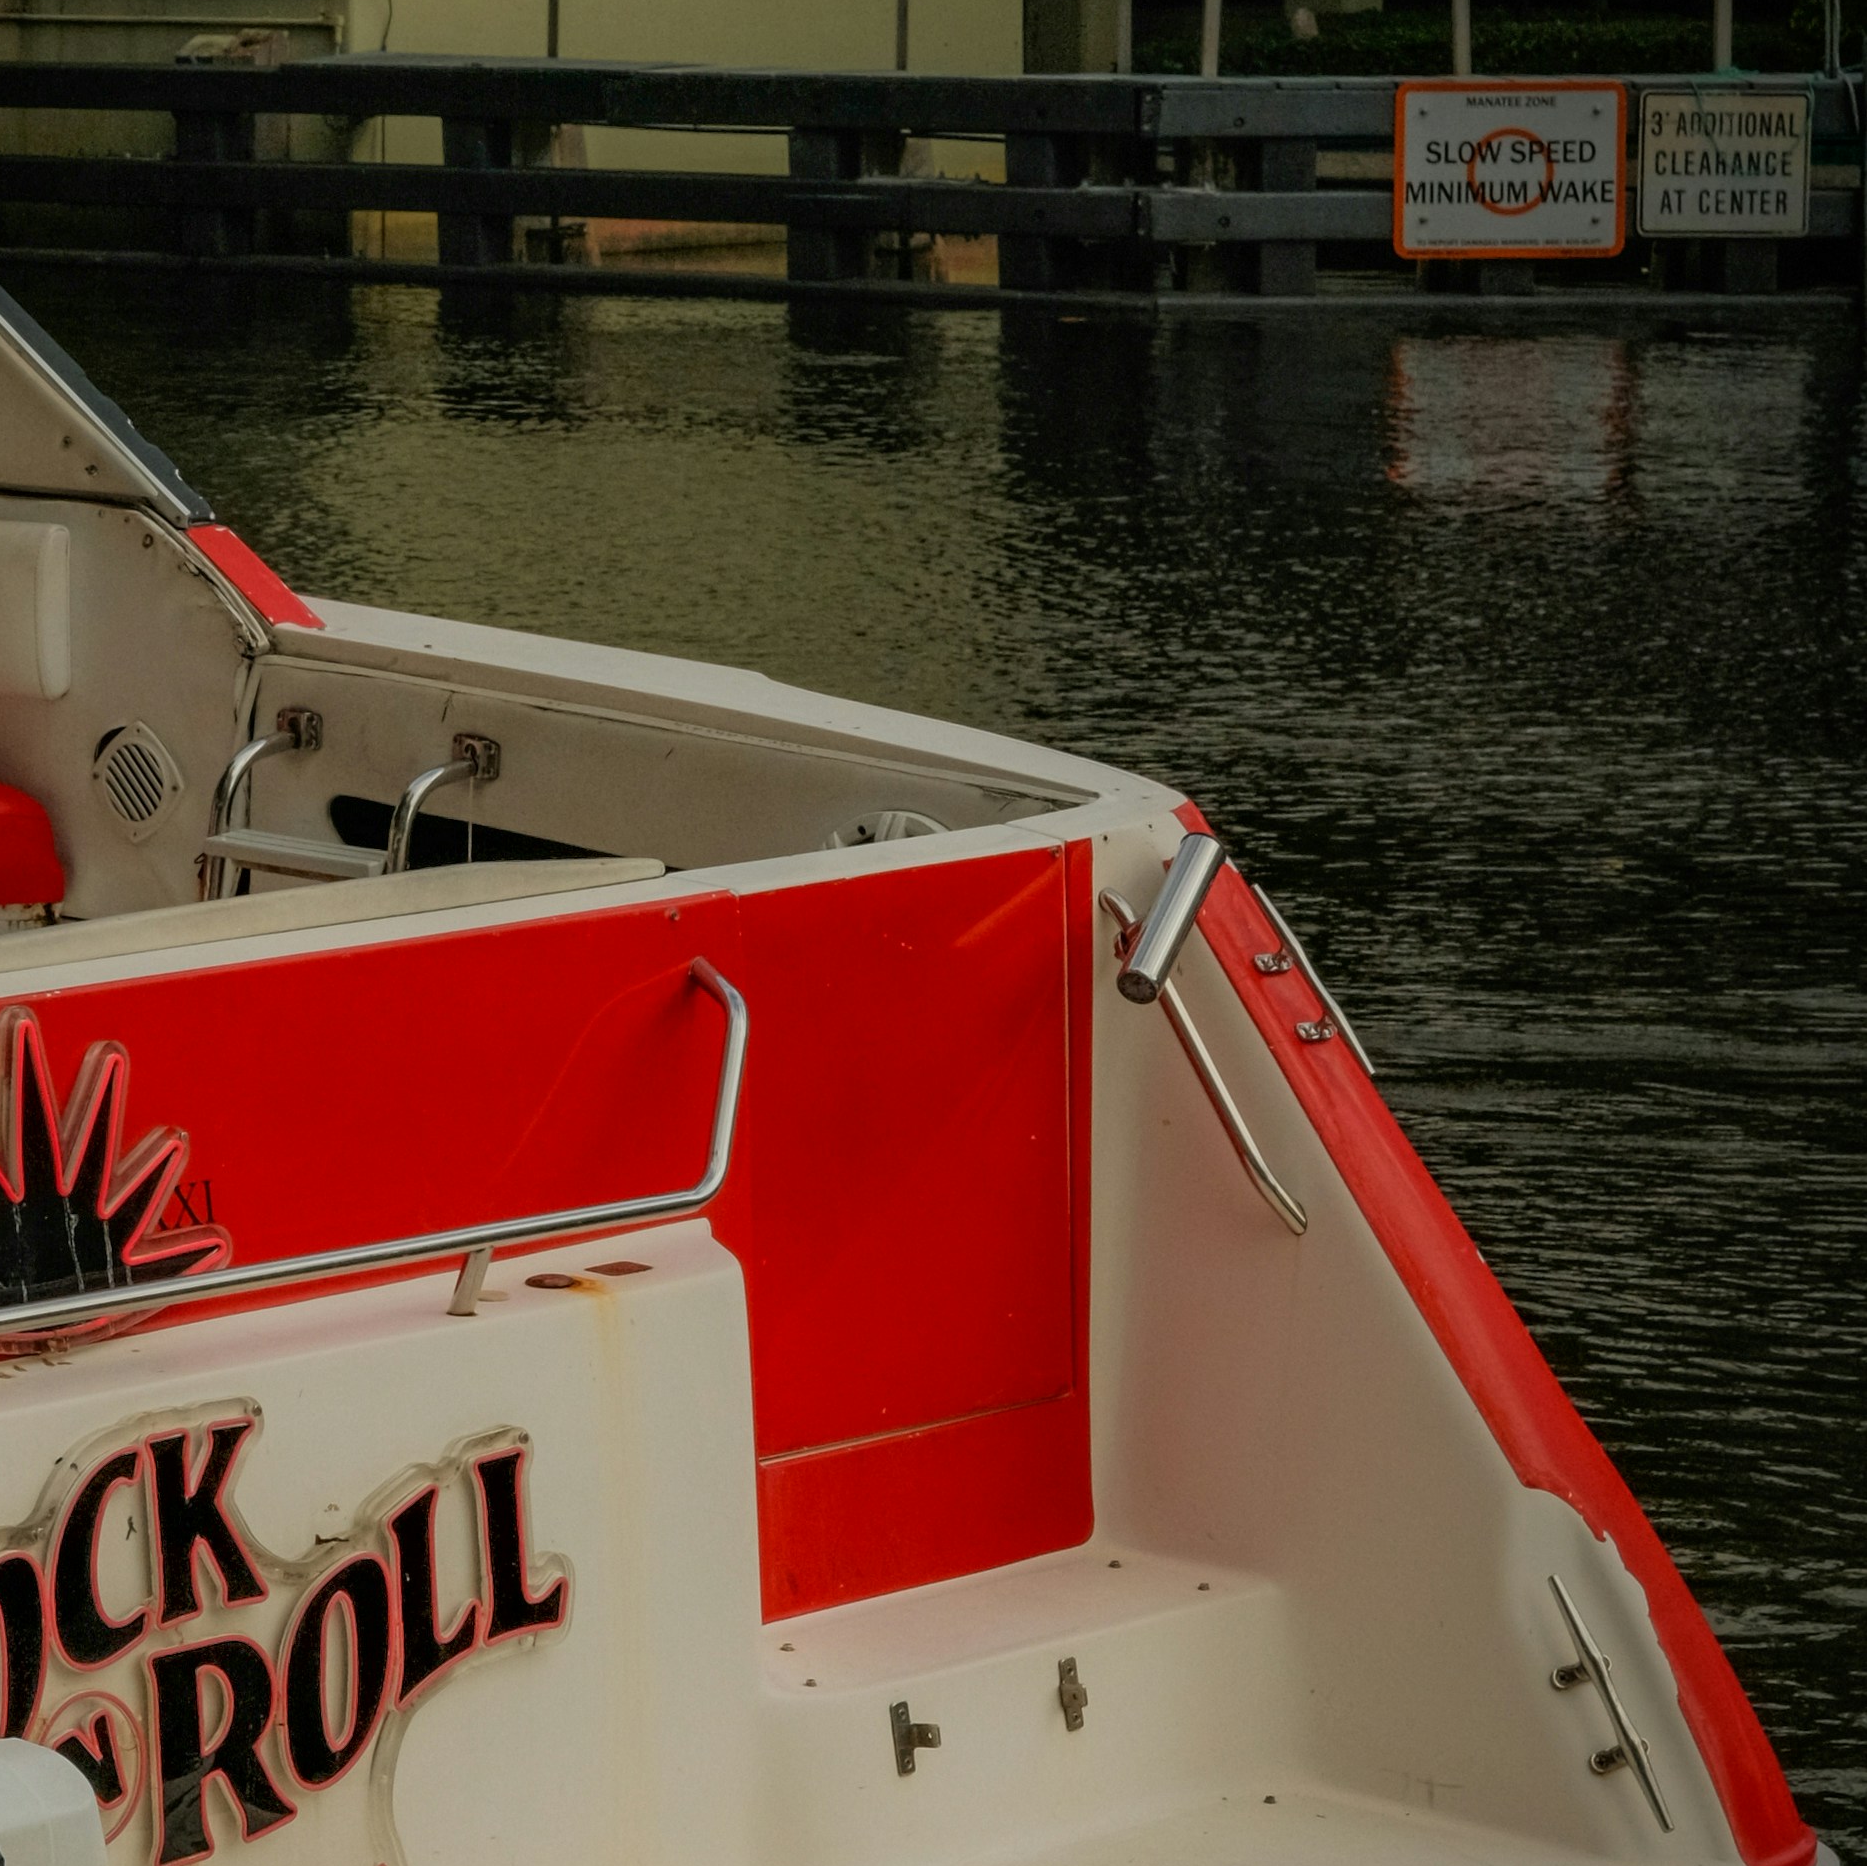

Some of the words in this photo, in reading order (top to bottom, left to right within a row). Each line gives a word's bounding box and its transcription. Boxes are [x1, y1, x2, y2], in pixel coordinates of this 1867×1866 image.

[1465, 96, 1522, 108] MANATEE
[1525, 96, 1558, 108] ZONE
[1675, 110, 1800, 139] ADDITIONAL
[1425, 140, 1500, 164] SLOW
[1510, 140, 1597, 164] SPEED
[1654, 150, 1794, 178] CLEARANCE
[1405, 181, 1529, 204] MINIMUM
[1538, 180, 1615, 204] WAKE
[1660, 189, 1685, 214] AT
[1698, 189, 1788, 216] CENTER
